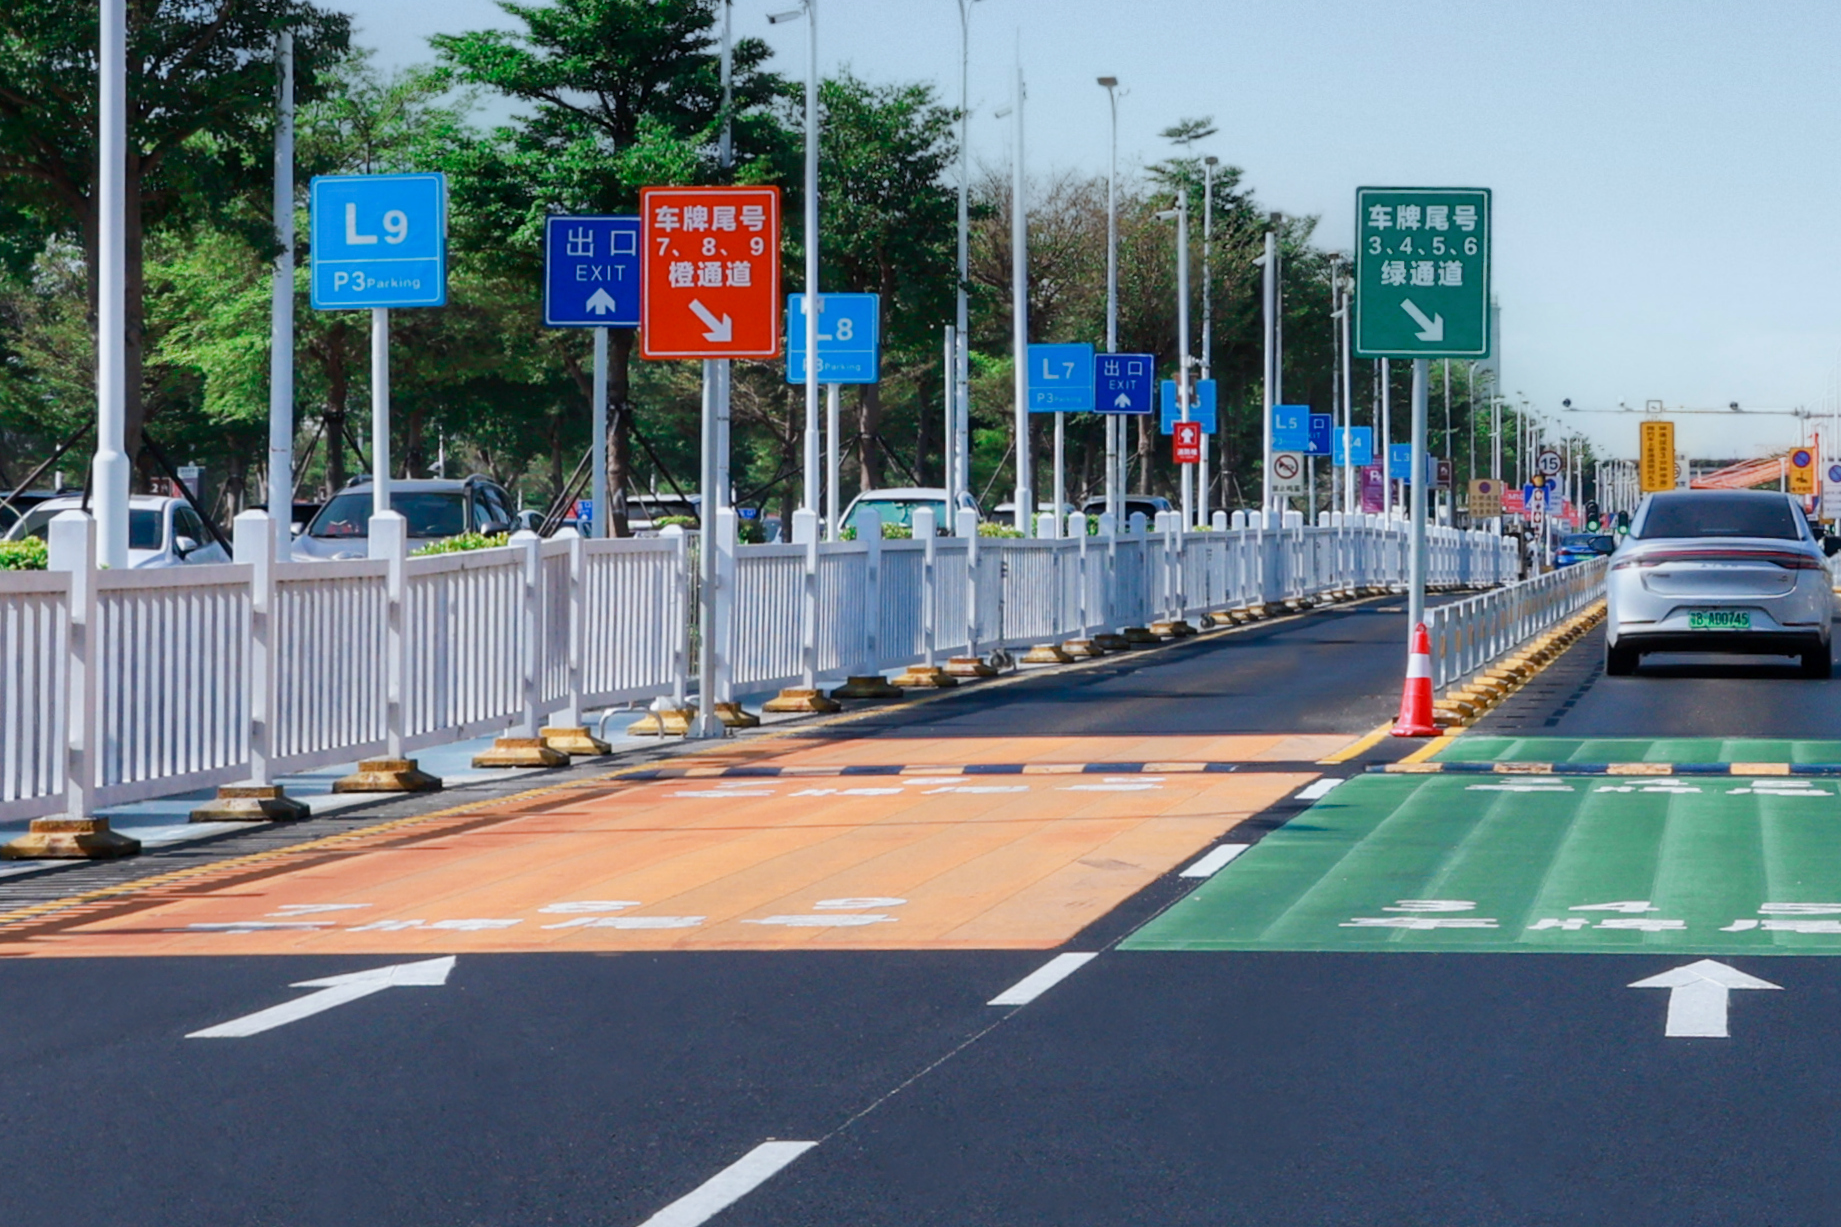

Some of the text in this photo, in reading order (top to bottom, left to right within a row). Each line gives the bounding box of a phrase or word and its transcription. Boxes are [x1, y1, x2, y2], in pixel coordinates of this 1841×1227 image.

[345, 202, 409, 246] L9
[654, 204, 767, 234] 车牌尾号
[1367, 203, 1478, 231] 车牌尾号
[566, 226, 637, 258] 出口
[575, 264, 627, 282] EXIT
[668, 260, 752, 289] 橙通道
[1381, 259, 1463, 286] 绿通道
[1042, 357, 1075, 380] L7
[1104, 360, 1143, 377] 出口
[1109, 379, 1137, 390] EXIT
[1275, 414, 1298, 429] L5
[1540, 458, 1559, 469] 15
[1381, 899, 1479, 912] 3
[1568, 900, 1661, 914] 4
